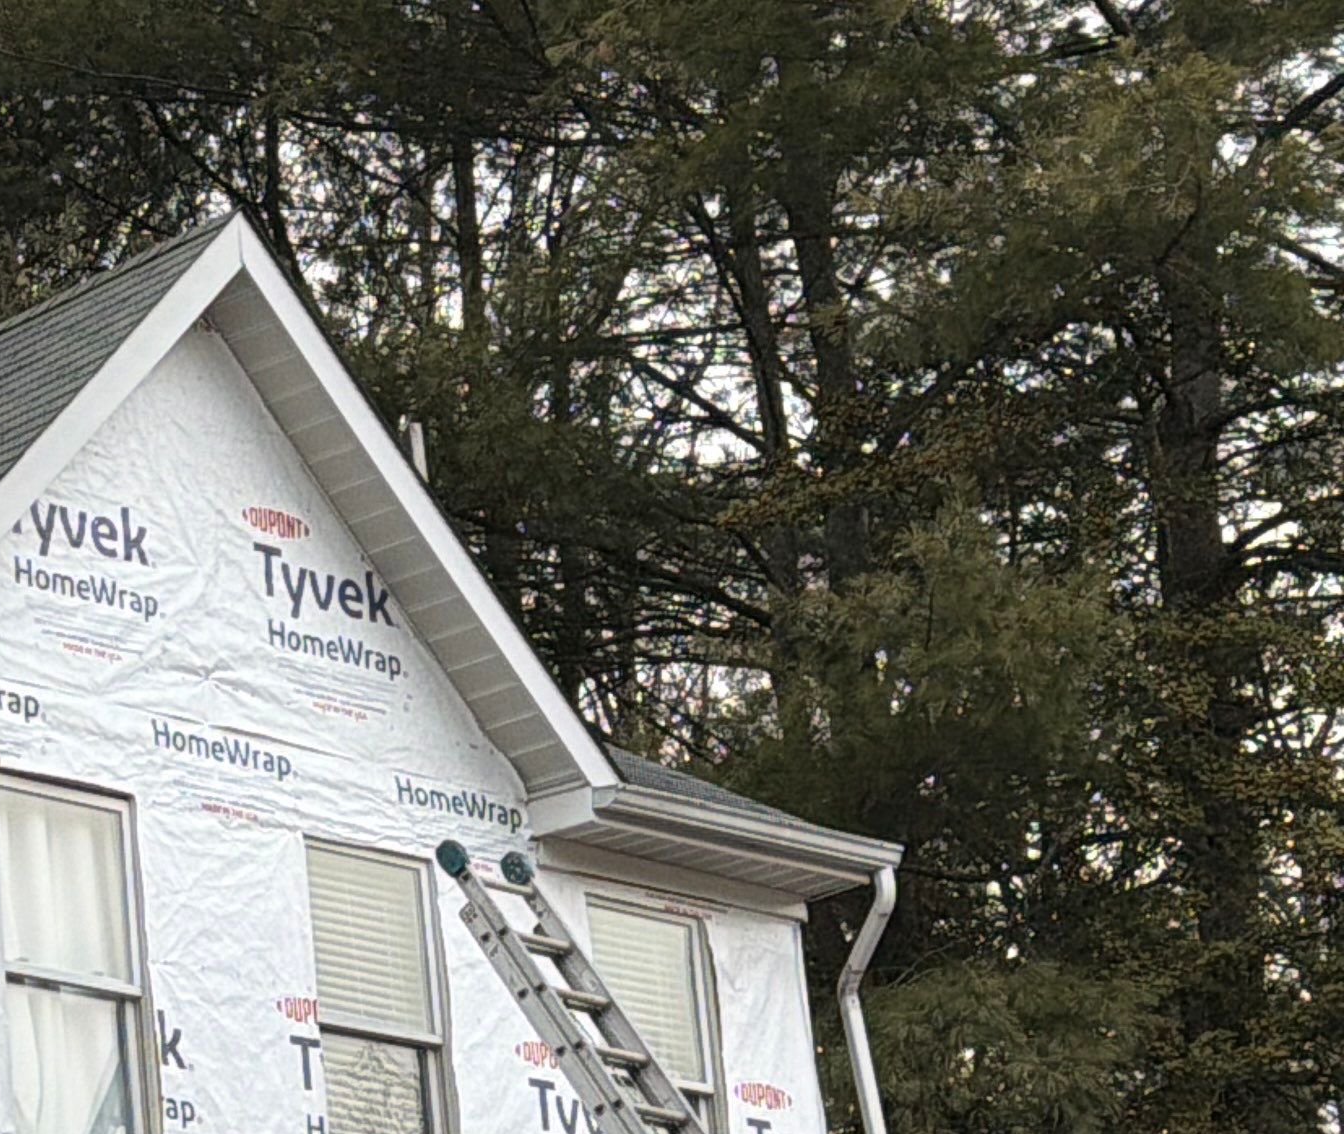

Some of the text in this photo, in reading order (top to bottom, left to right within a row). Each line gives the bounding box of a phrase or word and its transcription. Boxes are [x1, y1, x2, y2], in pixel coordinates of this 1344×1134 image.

[14, 501, 150, 567] yvek
[248, 506, 303, 540] DUPONT
[14, 557, 159, 620] HomeWrap
[253, 543, 392, 628] Tyvek
[268, 620, 403, 679] HomeWrap
[152, 719, 292, 779] HomeWrap
[395, 775, 523, 833] HomeWrap
[285, 997, 318, 1024] DUP
[741, 1083, 786, 1110] DUPONT
